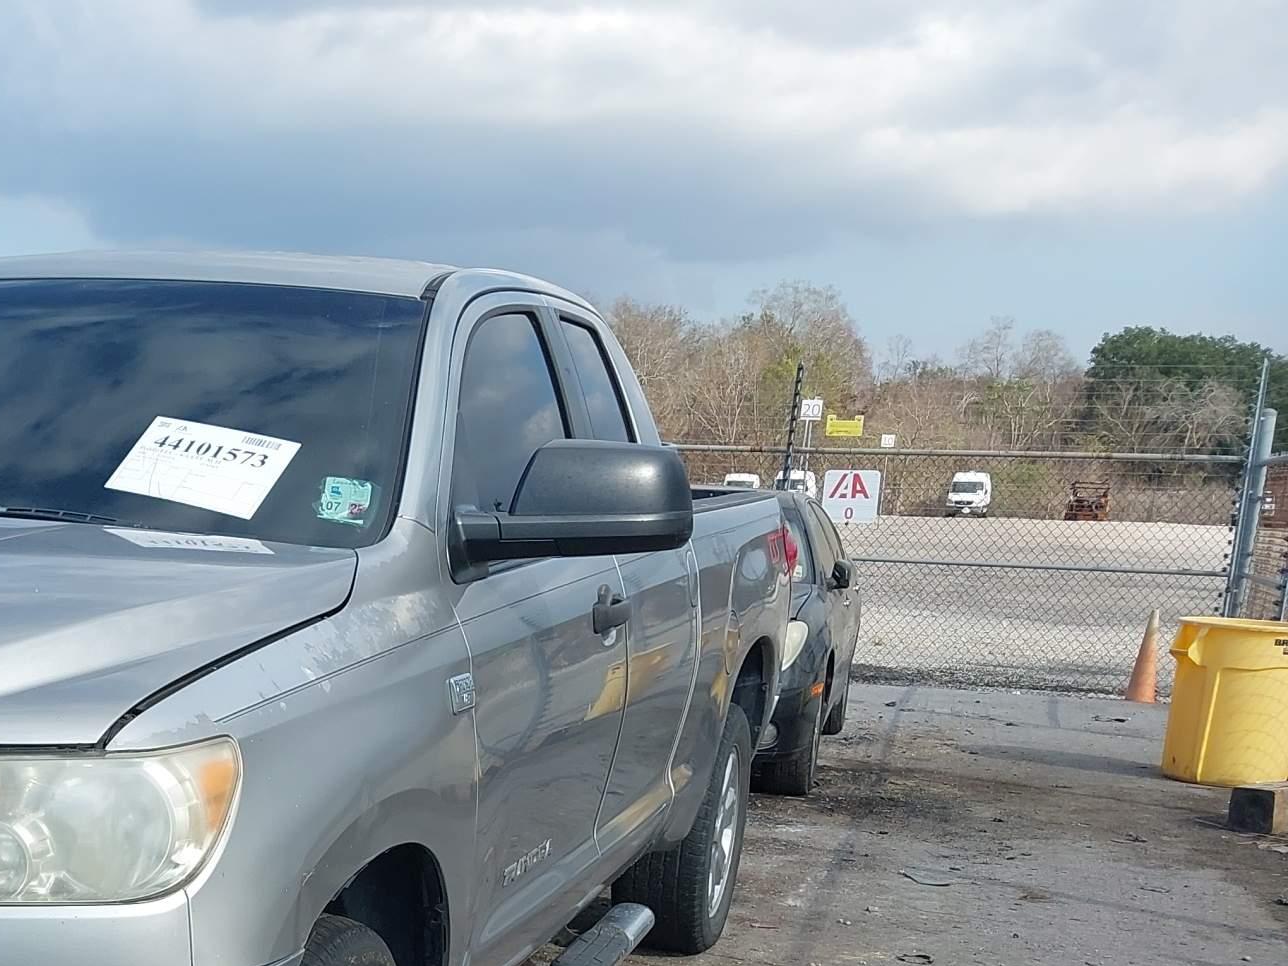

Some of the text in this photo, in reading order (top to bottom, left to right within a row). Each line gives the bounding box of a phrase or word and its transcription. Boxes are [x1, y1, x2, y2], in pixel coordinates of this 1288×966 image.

[802, 403, 821, 417] 20
[153, 435, 269, 468] 44101573
[326, 501, 342, 512] 07
[844, 507, 854, 520] 0
